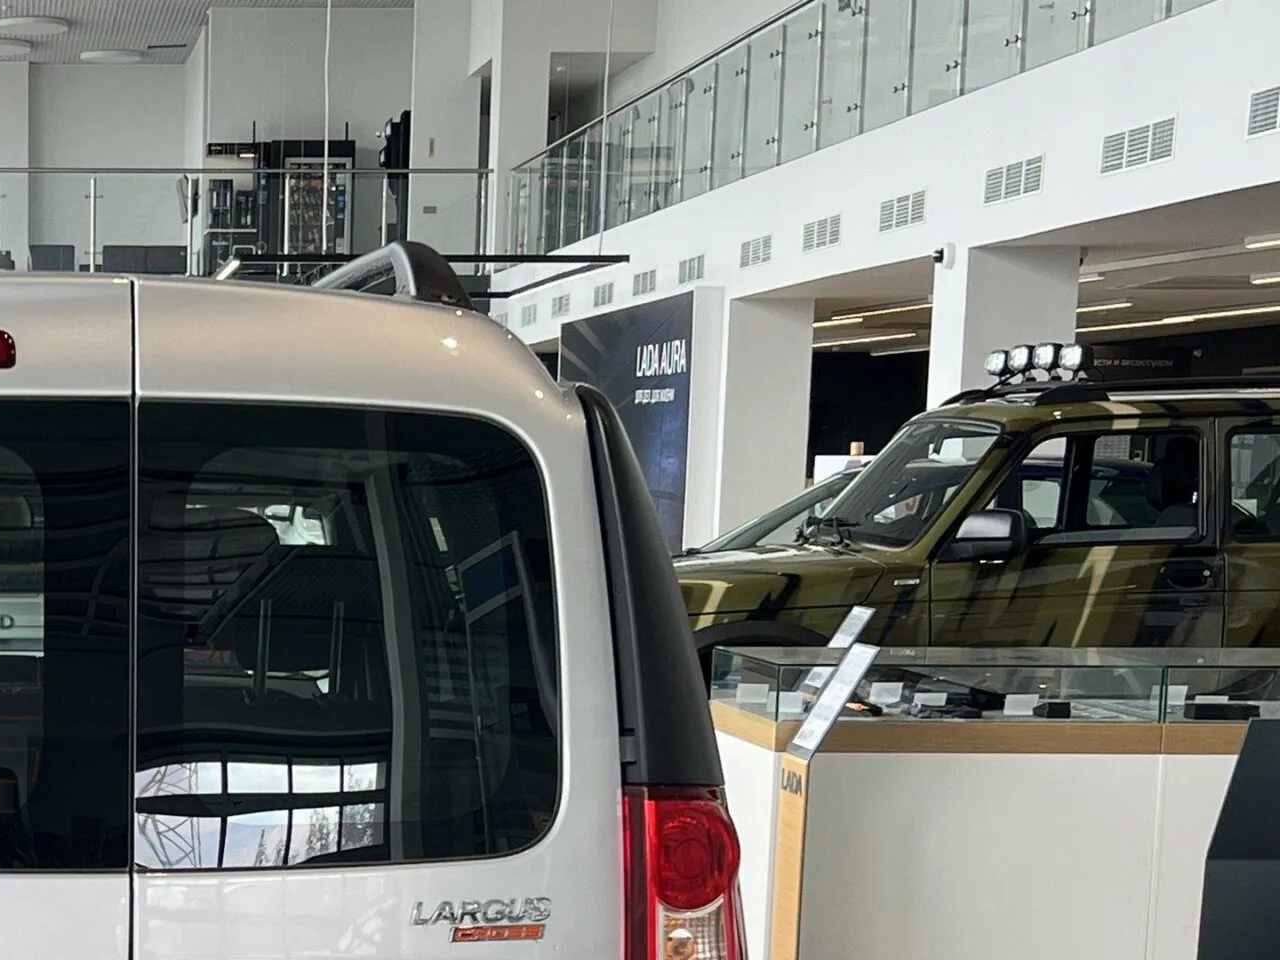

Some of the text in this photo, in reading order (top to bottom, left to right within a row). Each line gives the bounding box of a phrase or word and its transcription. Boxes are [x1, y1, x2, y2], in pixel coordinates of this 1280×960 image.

[636, 339, 686, 377] LADA AURA
[781, 767, 802, 797] LADA
[410, 897, 552, 926] LARGUS
